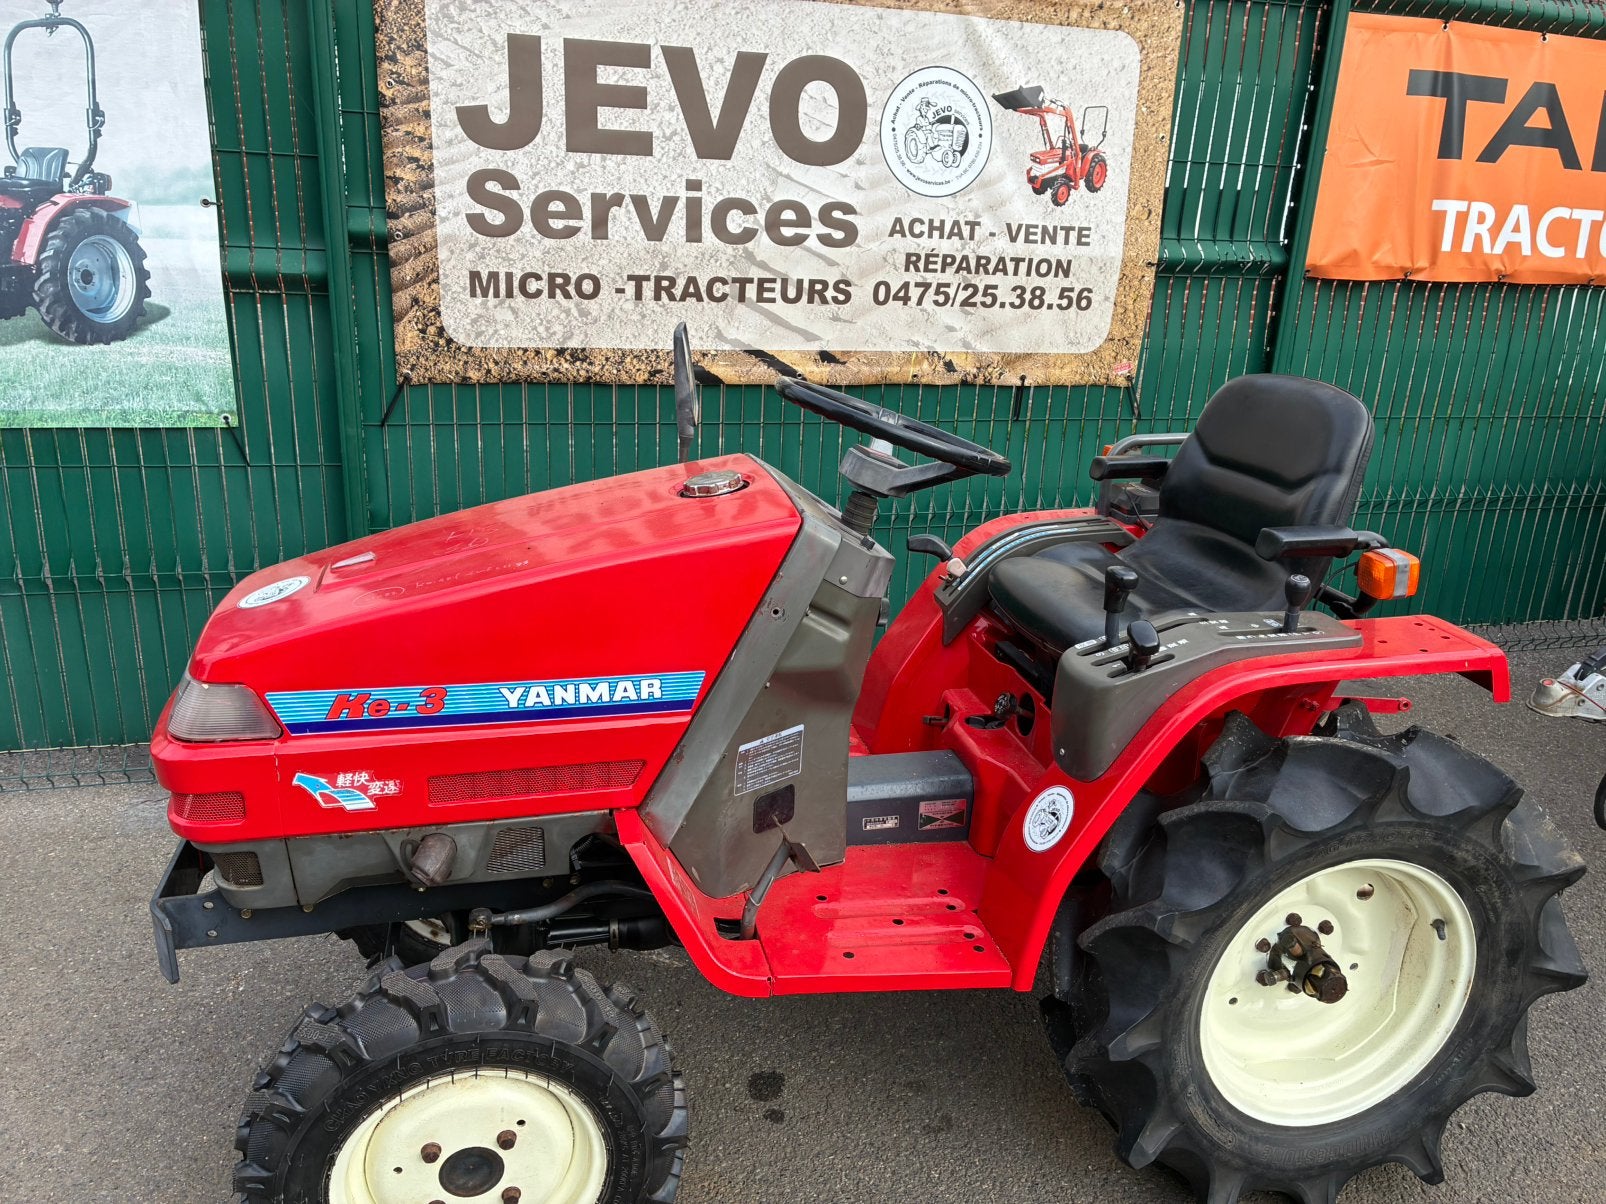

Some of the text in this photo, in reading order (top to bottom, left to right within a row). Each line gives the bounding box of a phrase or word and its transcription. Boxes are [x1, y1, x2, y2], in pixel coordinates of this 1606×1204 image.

[455, 33, 868, 167] JEVO
[932, 105, 952, 120] JEVO
[1405, 68, 1606, 173] TA
[464, 168, 859, 249] Services
[888, 216, 981, 241] ACHAT
[1005, 222, 1092, 247] VENTE
[903, 249, 1073, 279] RÉPARATION
[469, 270, 602, 301] MICRO
[872, 280, 1094, 312] 0475/25.38.56
[325, 677, 663, 720] Ke-3 YANMAR
[336, 771, 369, 787] 軽快
